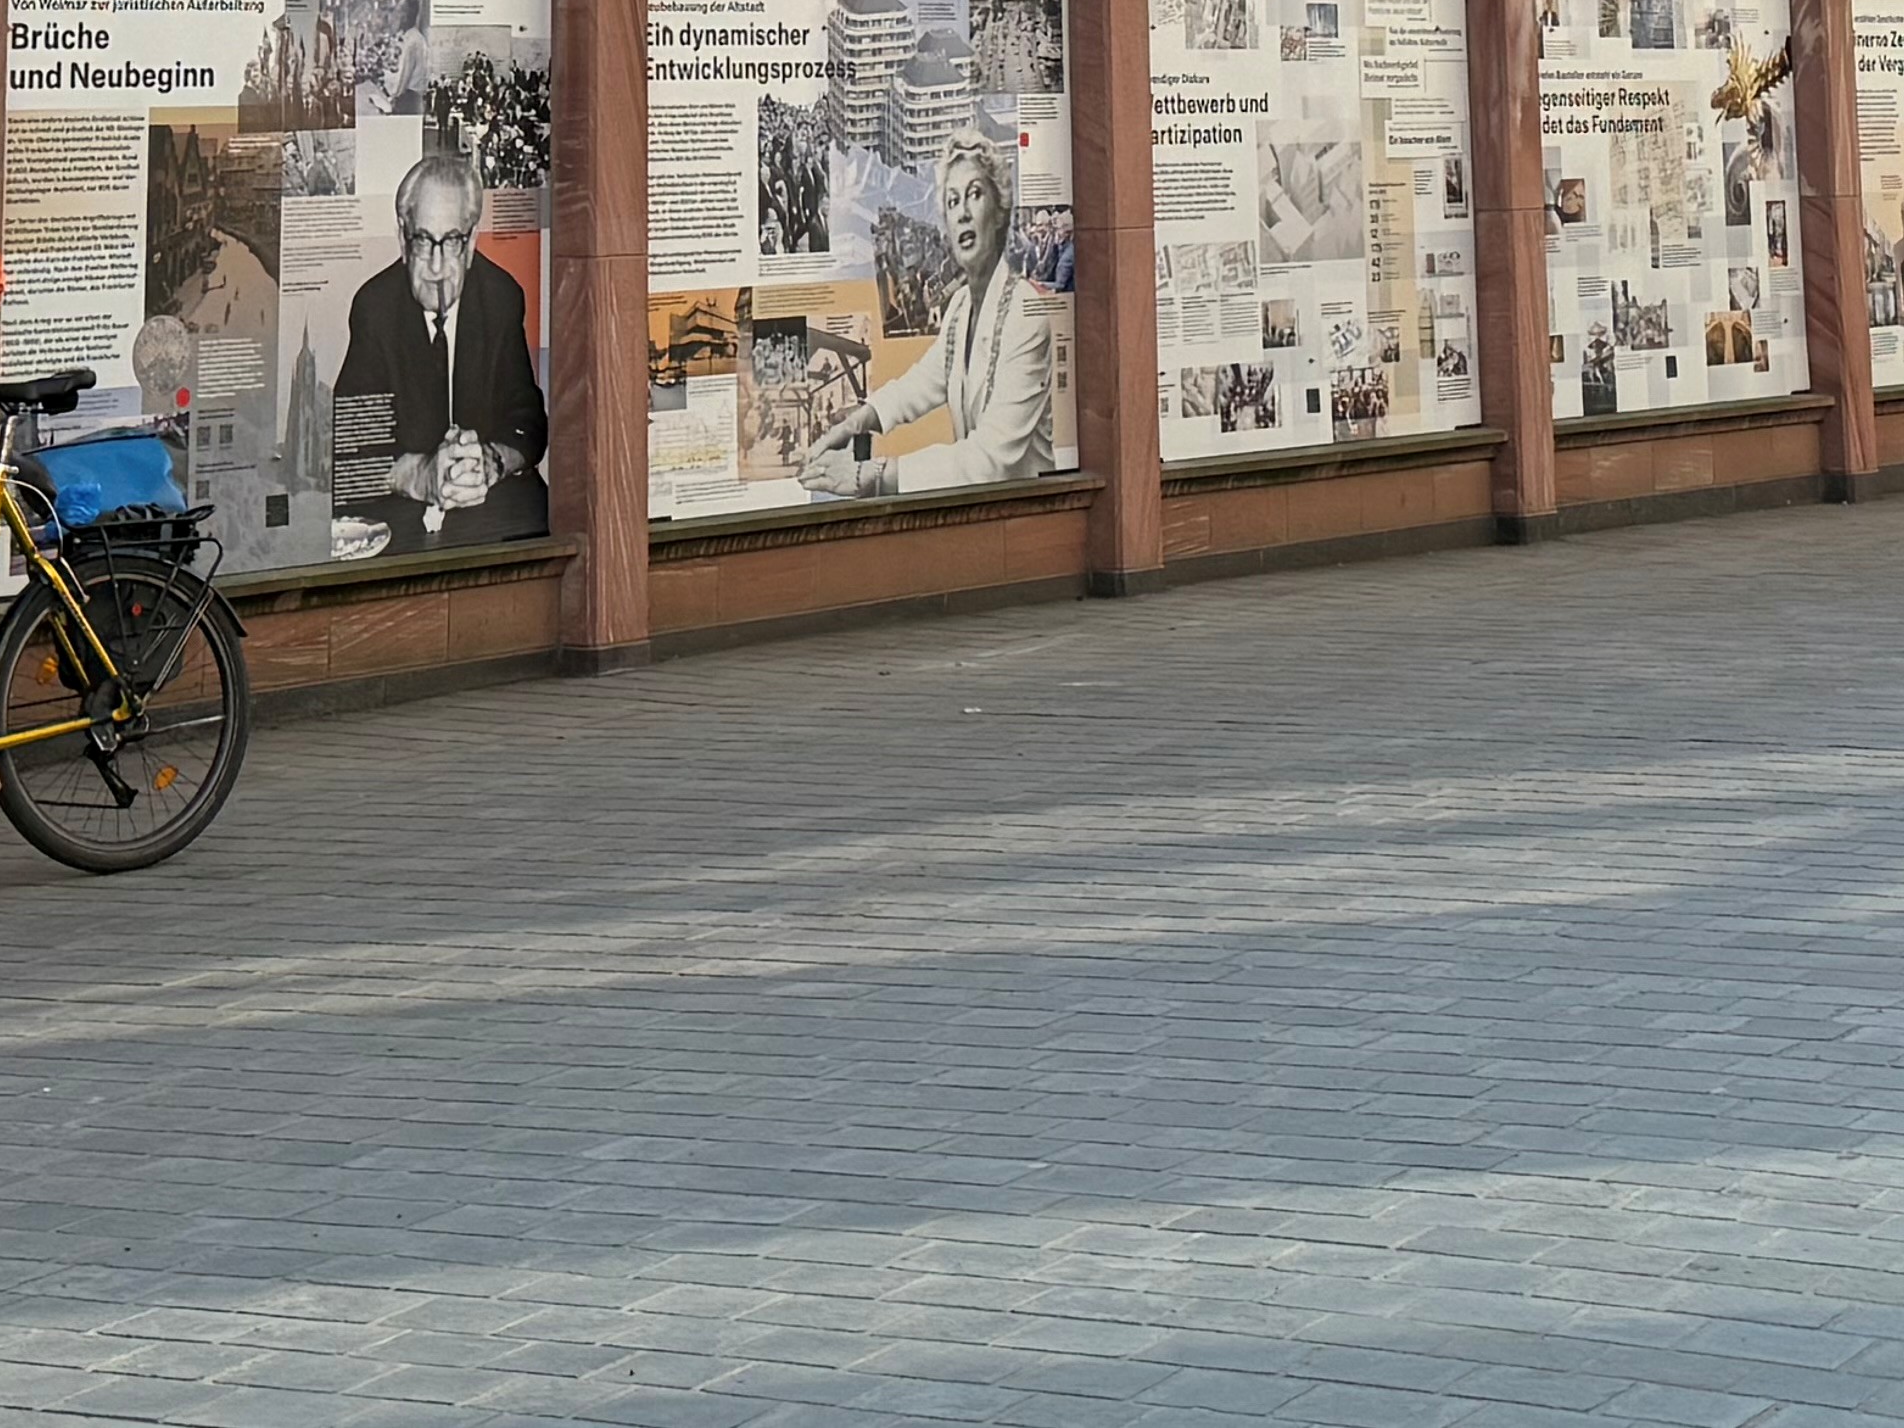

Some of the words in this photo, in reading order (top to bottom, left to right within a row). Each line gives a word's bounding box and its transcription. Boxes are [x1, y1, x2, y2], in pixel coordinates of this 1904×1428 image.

[11, 22, 109, 50] Brüche
[680, 22, 810, 51] dynamischer
[648, 56, 857, 84] Entwicklungsprozess
[1858, 54, 1876, 72] der
[10, 61, 62, 89] und
[70, 61, 215, 93] Neubeginn
[1152, 92, 1235, 114] ettbewerb
[1239, 92, 1268, 113] und
[1540, 87, 1616, 111] genseitiger
[1618, 86, 1670, 110] Respekt
[1566, 114, 1589, 134] das
[1592, 112, 1664, 134] Fundament
